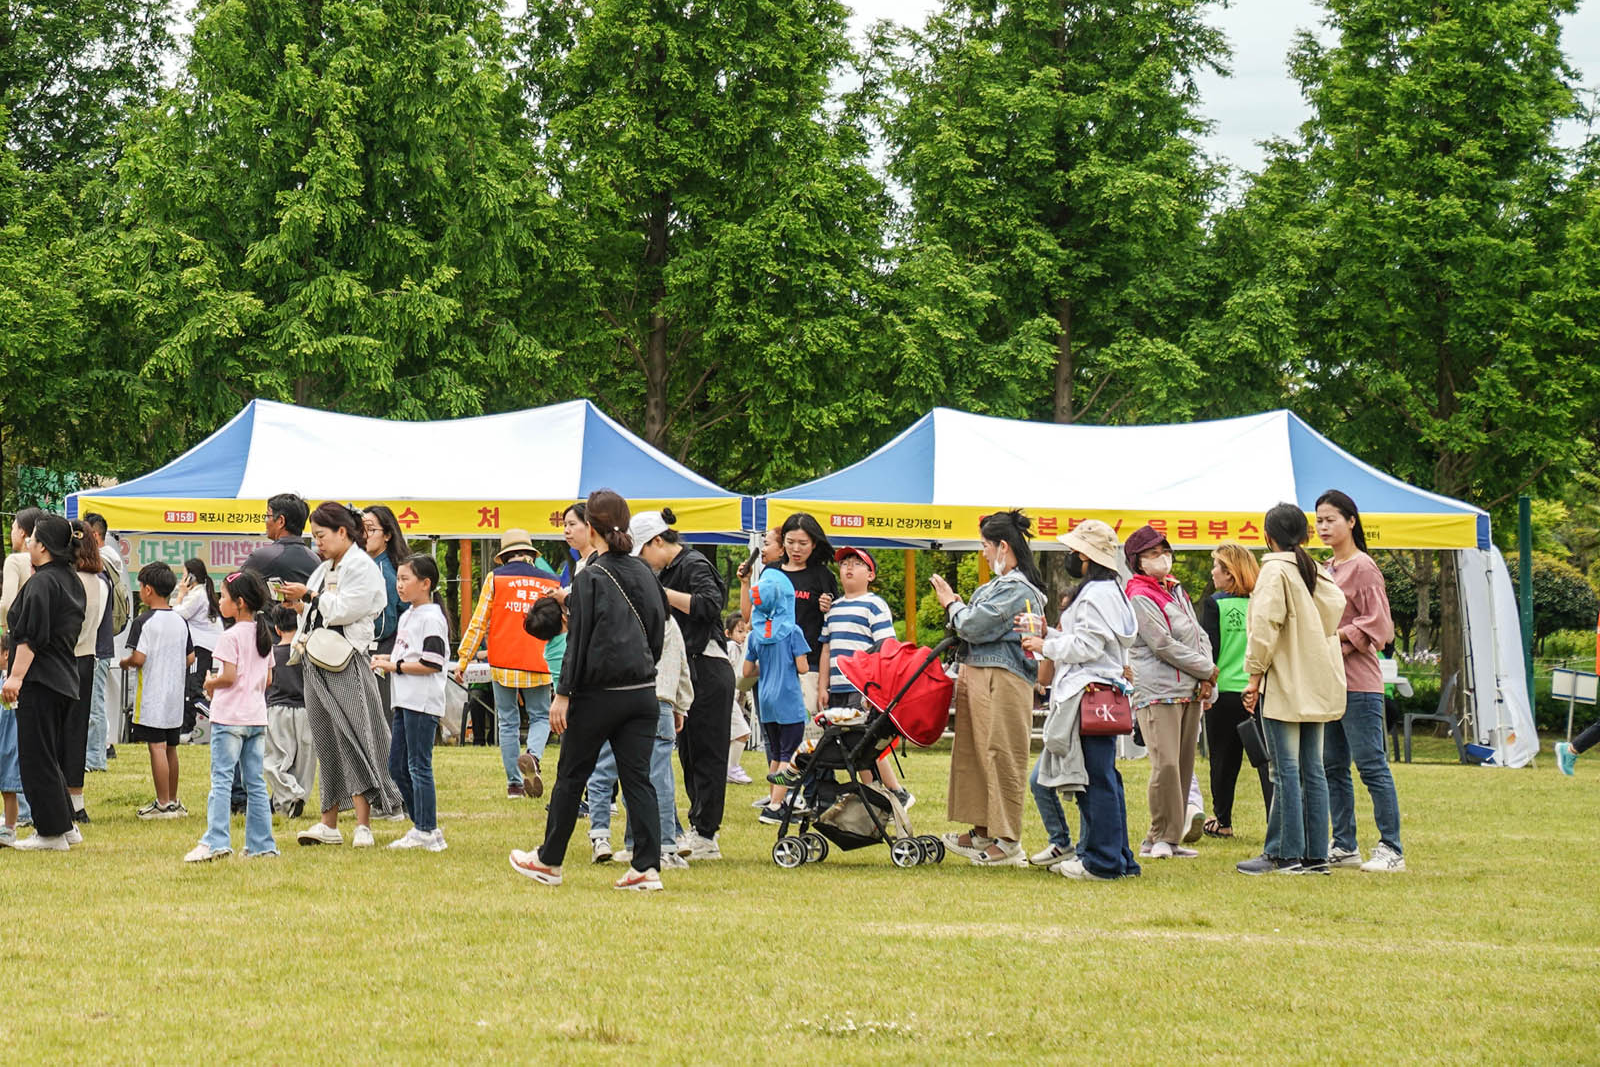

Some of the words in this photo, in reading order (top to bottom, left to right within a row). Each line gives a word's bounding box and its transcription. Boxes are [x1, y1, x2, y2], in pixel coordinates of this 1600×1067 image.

[166, 512, 195, 522] 제15회
[199, 512, 225, 523] 목포시
[398, 507, 419, 529] 수
[477, 507, 500, 529] 처
[832, 515, 862, 526] 제15회
[867, 517, 894, 528] 목포시
[896, 518, 941, 529] 건강가정의
[944, 519, 952, 529] 날
[505, 602, 530, 614] 시민참
